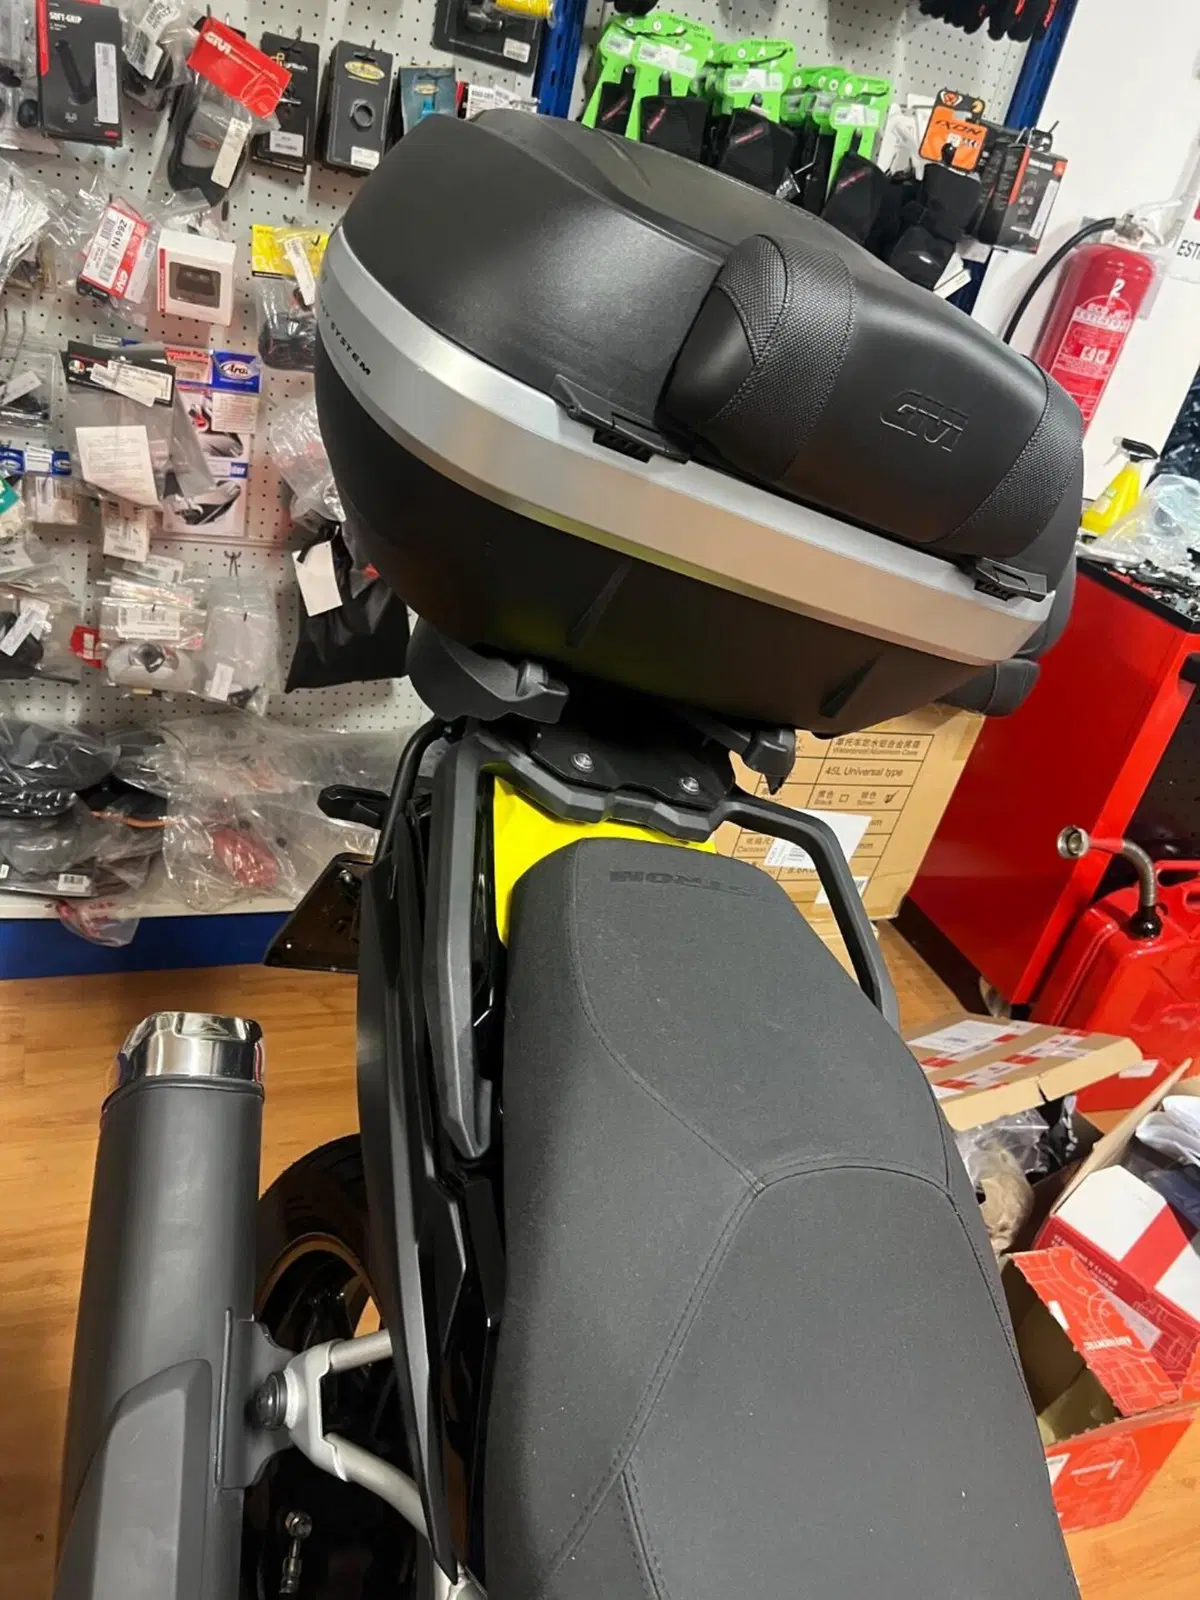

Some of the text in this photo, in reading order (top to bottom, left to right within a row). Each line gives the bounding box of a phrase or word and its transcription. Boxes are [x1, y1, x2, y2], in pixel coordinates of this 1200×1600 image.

[203, 31, 232, 55] GIVI
[934, 119, 982, 136] IXON
[108, 218, 129, 249] Z661N
[1176, 239, 1200, 261] EST
[329, 320, 372, 376] SYSTEM
[879, 389, 969, 453] GIVI
[825, 766, 904, 779] 45L Universal type
